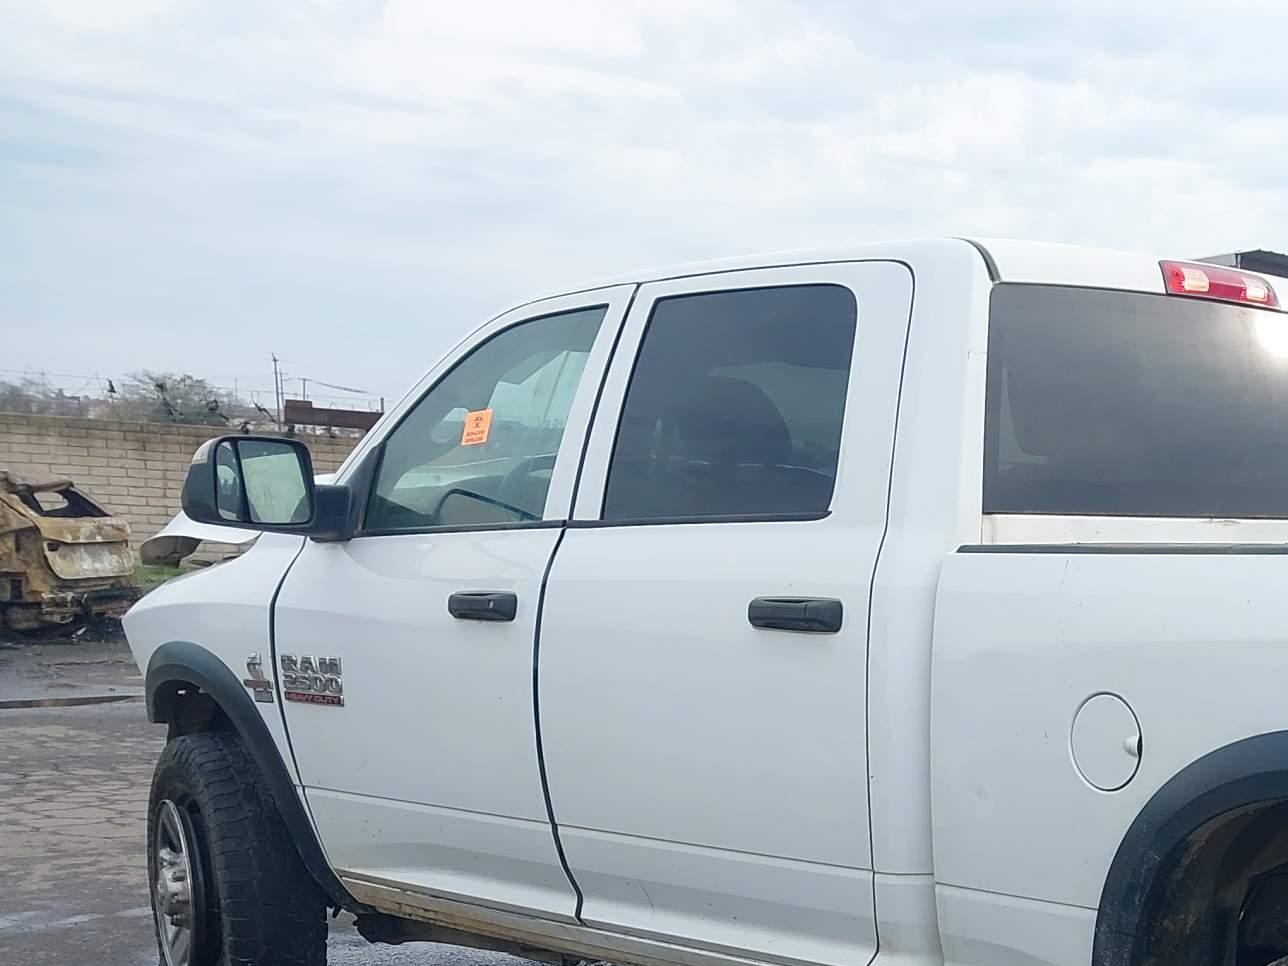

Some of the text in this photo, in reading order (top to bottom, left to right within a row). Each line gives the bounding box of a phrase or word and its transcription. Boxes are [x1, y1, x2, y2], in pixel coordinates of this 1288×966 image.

[280, 654, 342, 676] RAM
[282, 672, 343, 694] 2500
[313, 694, 340, 705] DUTY
